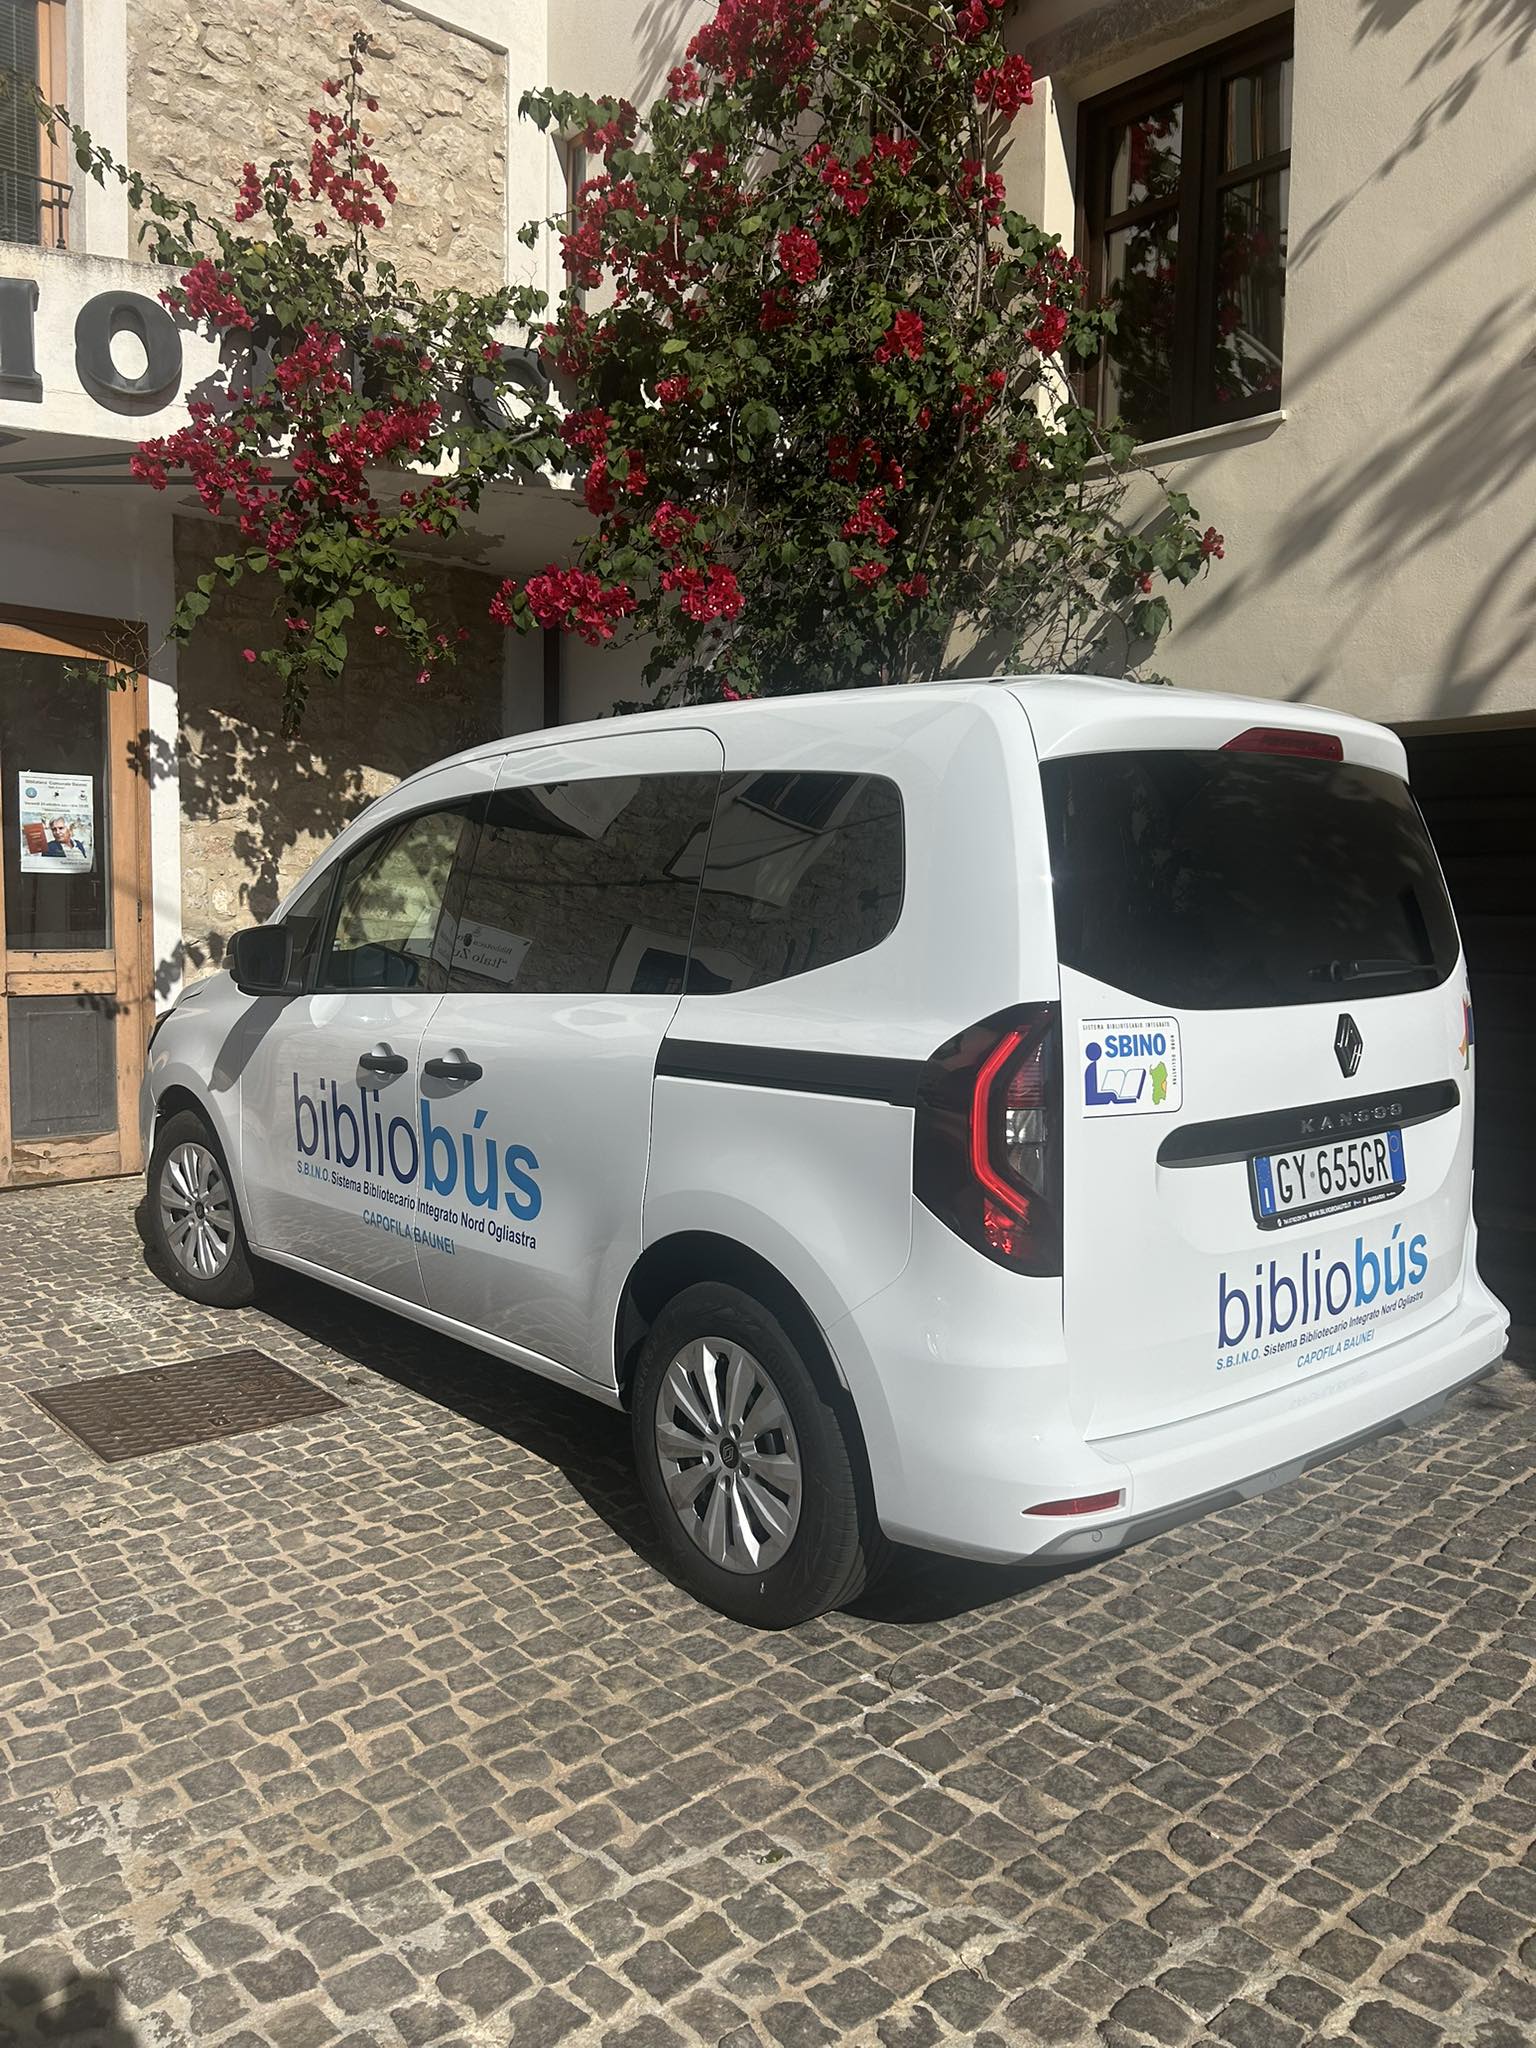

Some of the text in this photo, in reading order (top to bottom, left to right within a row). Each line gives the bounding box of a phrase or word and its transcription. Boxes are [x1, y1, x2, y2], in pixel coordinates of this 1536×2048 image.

[1104, 1032, 1167, 1059] SBINO
[1106, 1022, 1143, 1030] BIBLIOTECARIO
[1145, 1020, 1171, 1029] INTEGRATO
[1301, 1103, 1402, 1134] KANGOO
[293, 1072, 543, 1222] bibliobús
[297, 1160, 537, 1250] S.B.I.N.O. Sistema Bibliotecario Integrato Nord Ogliastra
[363, 1209, 456, 1256] CAPOFILA BAUNEI
[1217, 1223, 1428, 1349] bibliobús
[1216, 1290, 1424, 1370] S.B.I.N.O. Sistema Bibliotecario Integrato Nord Ogliastra
[1297, 1327, 1375, 1368] CAPOFILA BAUNEI
